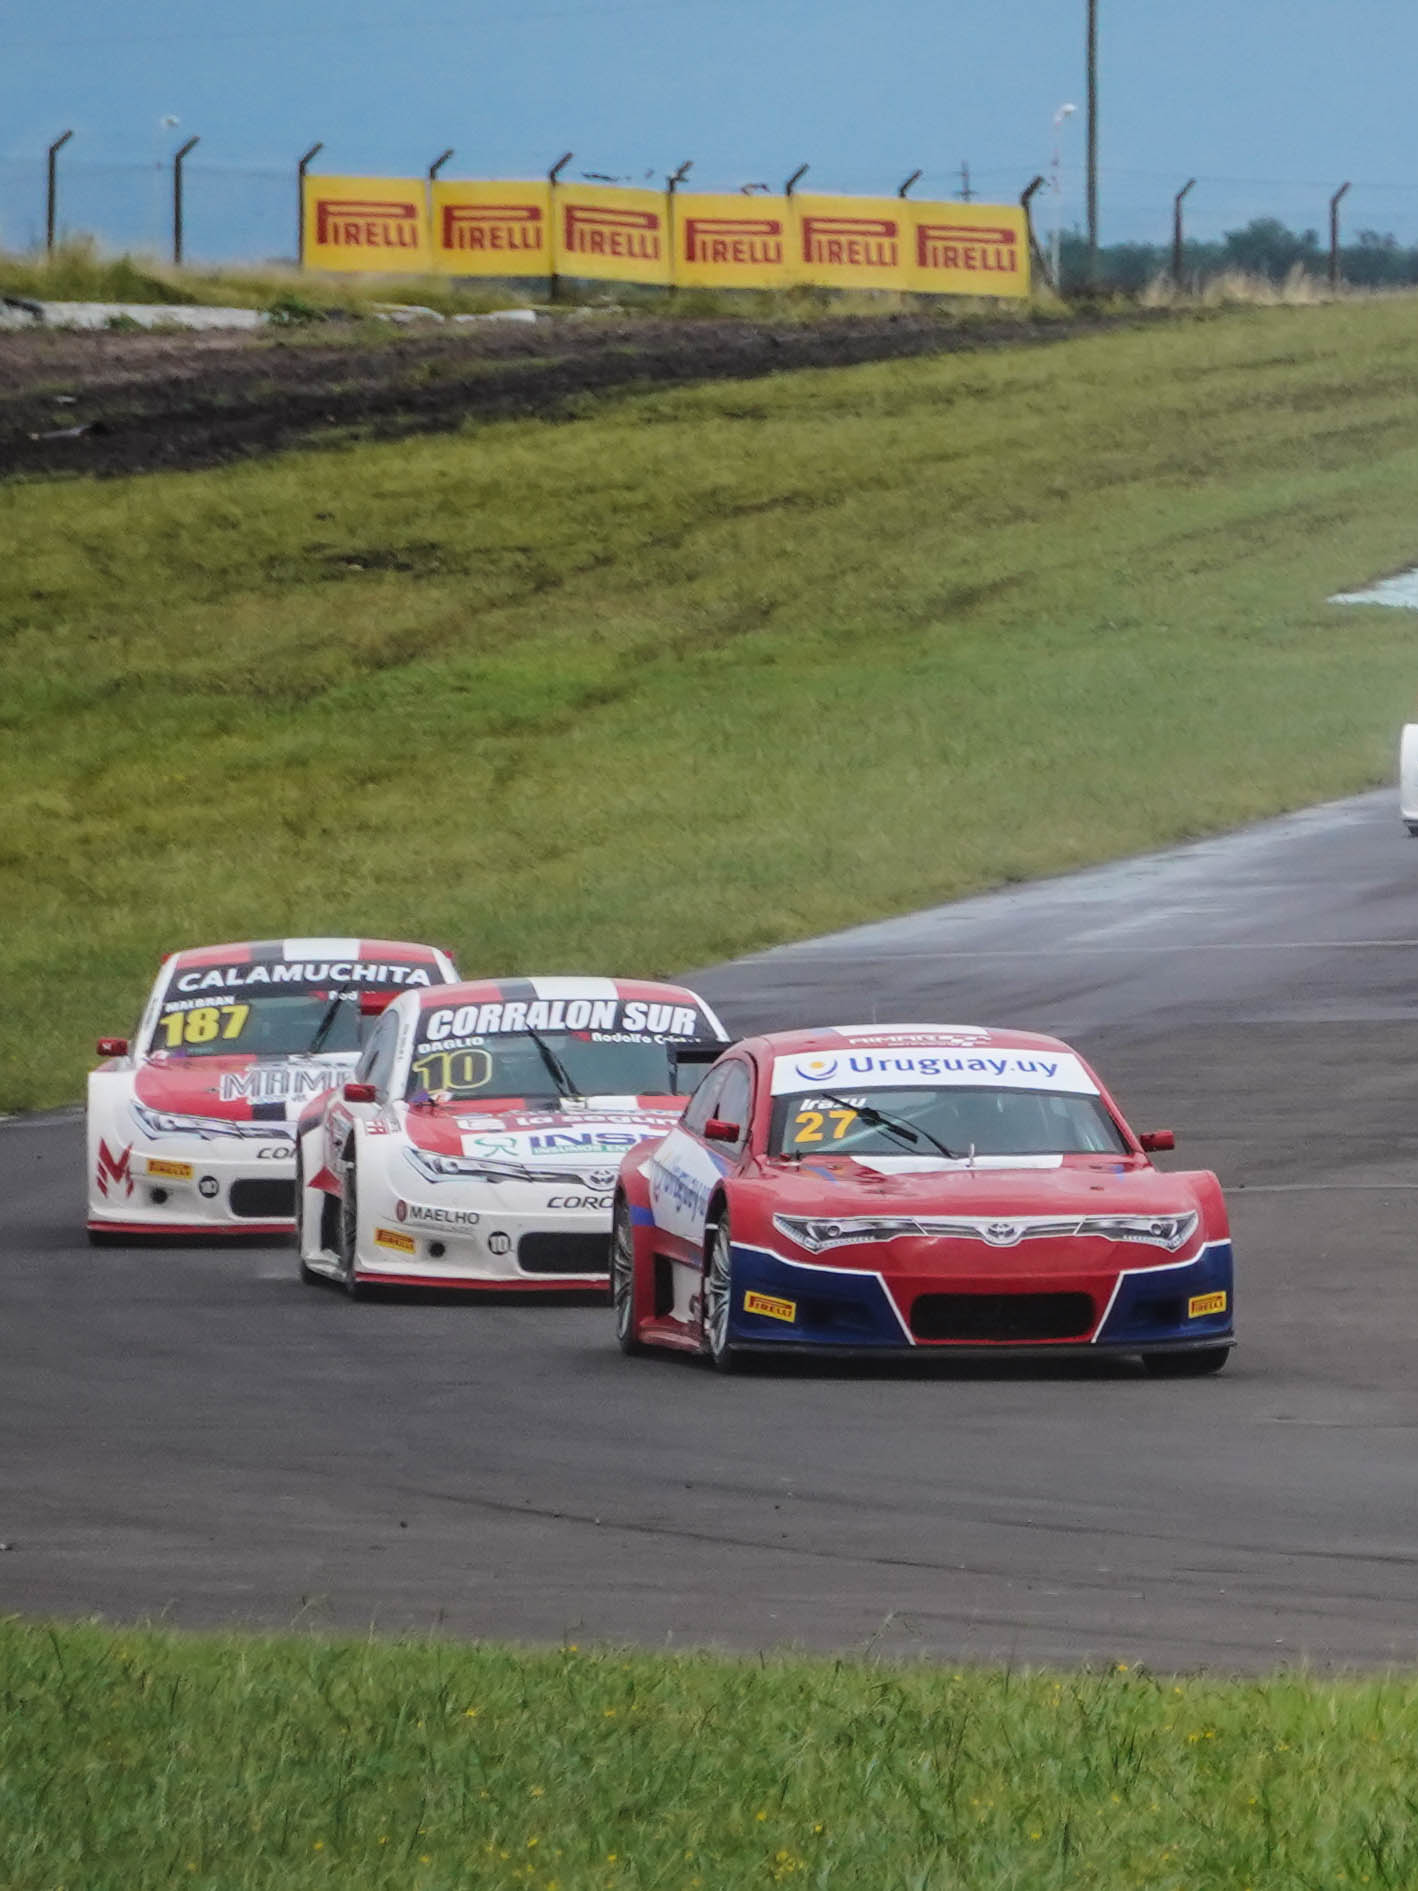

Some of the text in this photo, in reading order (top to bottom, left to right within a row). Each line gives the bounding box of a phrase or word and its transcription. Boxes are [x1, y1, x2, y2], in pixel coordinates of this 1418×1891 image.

[317, 200, 418, 246] PIRELLI
[443, 204, 542, 249] PIRELLI
[565, 204, 660, 260] PIRELLI
[685, 218, 782, 264] PIRELLI
[803, 217, 897, 267] PIRELLI
[917, 224, 1017, 272] PIRELLI
[176, 963, 431, 993] CALAMUCHITA
[160, 1004, 249, 1048] 187
[426, 1000, 697, 1041] CORRALON SUR
[412, 1049, 492, 1094] 10
[849, 1056, 1058, 1078] Uruguay.uy
[794, 1109, 858, 1142] 27
[409, 1206, 480, 1225] MAELHO
[749, 1295, 793, 1318] PIRELLI
[1191, 1295, 1224, 1313] PIRELLI
